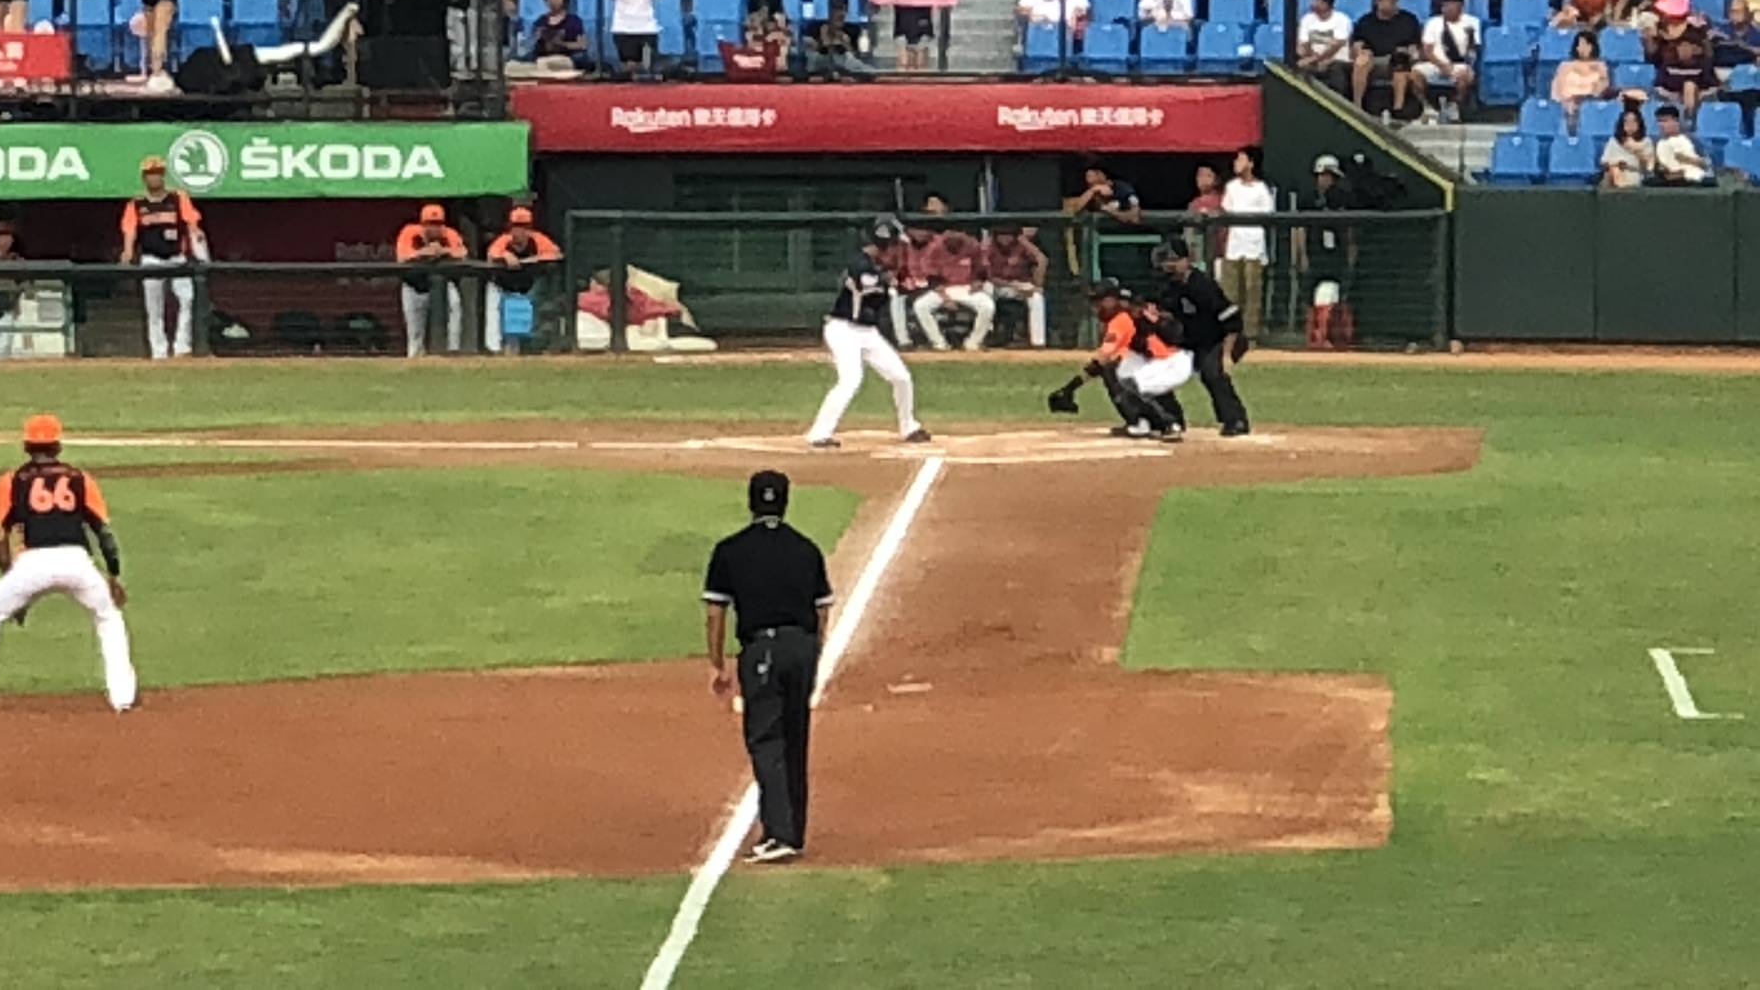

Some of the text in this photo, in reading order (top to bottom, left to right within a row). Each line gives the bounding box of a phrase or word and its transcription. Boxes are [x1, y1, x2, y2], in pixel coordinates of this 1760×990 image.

[610, 107, 691, 133] Rakuten
[997, 105, 1079, 131] Rakuten
[240, 138, 445, 180] ŠKODA
[29, 477, 76, 513] 66
